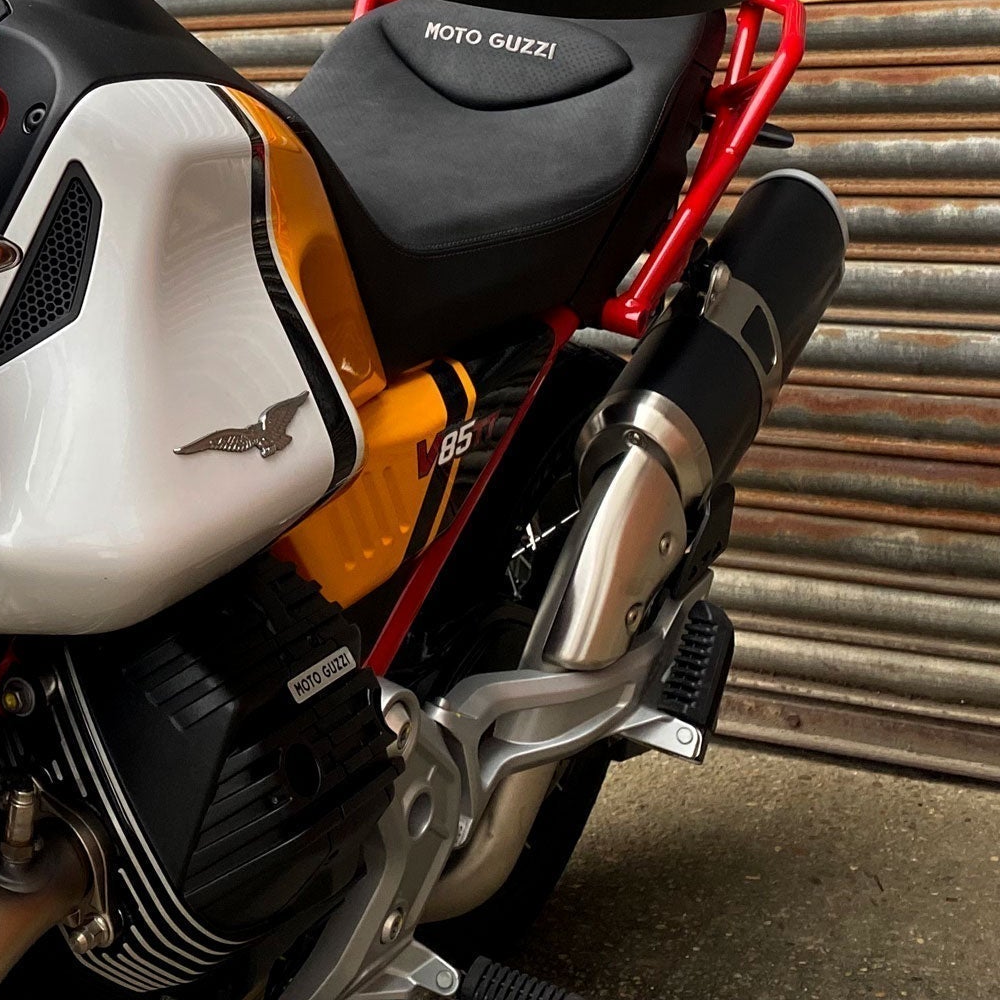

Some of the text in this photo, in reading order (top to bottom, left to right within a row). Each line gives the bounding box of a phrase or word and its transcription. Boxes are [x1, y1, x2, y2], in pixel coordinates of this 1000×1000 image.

[424, 21, 558, 60] MOTO GUZZI
[293, 652, 351, 697] MOTO GUZZI
